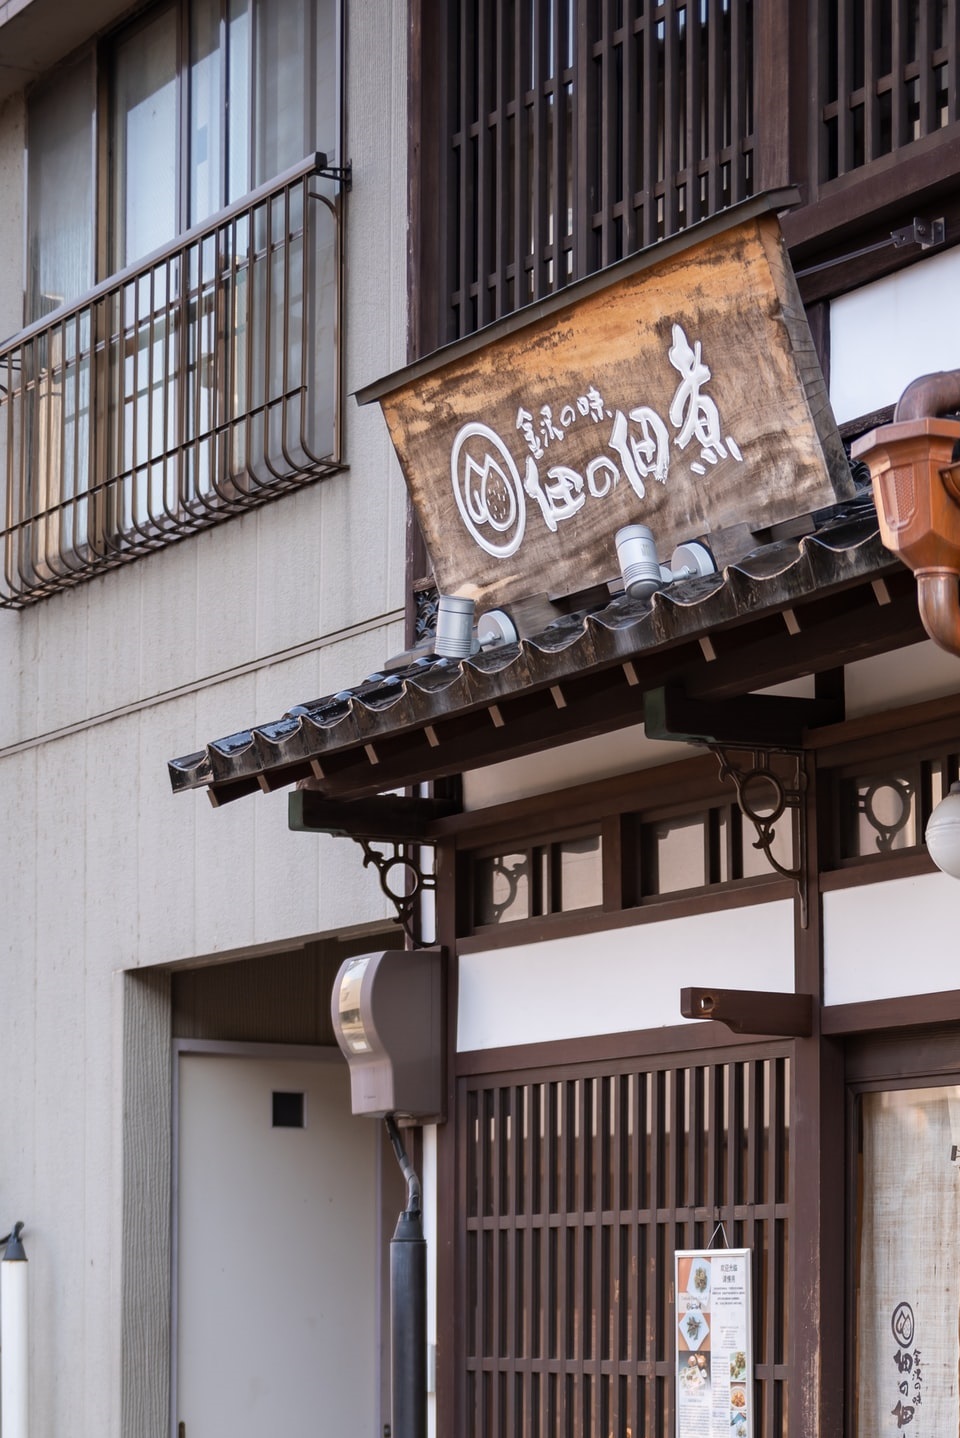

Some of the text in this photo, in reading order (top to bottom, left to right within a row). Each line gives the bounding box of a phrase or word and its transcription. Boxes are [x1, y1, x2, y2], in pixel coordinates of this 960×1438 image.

[515, 385, 613, 460] 金沢の味
[523, 322, 742, 532] 佃の佃煮
[912, 1348, 923, 1405] 金沢の味
